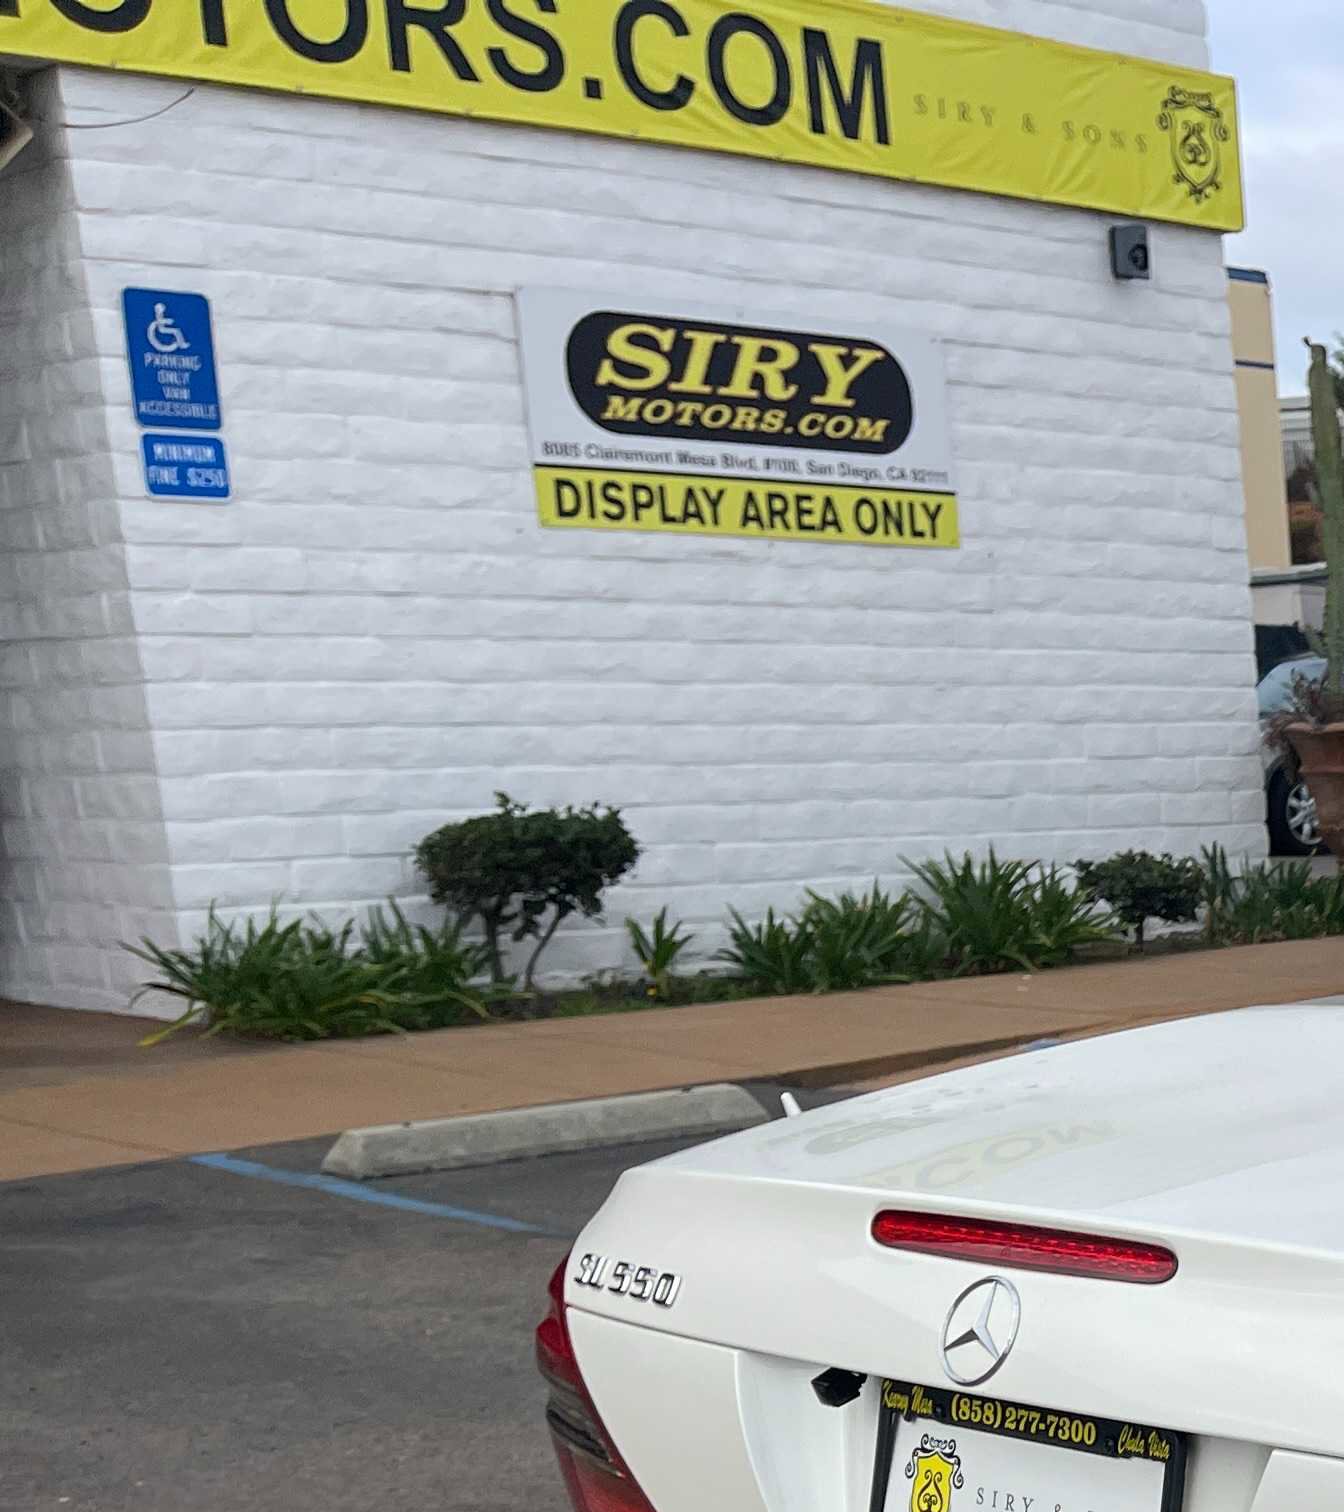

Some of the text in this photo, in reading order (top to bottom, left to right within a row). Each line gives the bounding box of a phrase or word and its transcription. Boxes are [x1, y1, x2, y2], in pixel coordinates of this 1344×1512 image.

[0, 0, 892, 146] ORS.COM
[913, 94, 1149, 153] SIRY & SONS
[144, 353, 202, 371] PARKING
[157, 371, 190, 385] ONLY
[595, 322, 886, 408] SIRY
[163, 386, 190, 400] VAN
[139, 402, 218, 420] ACCESSIBLE
[601, 395, 891, 443] MOTORS.COM
[153, 442, 216, 463] MINIMUM
[149, 466, 226, 488] FINE $250
[553, 478, 943, 540] DISPLAY AREA ONLY
[951, 1393, 1097, 1446] (858) 277-7300
